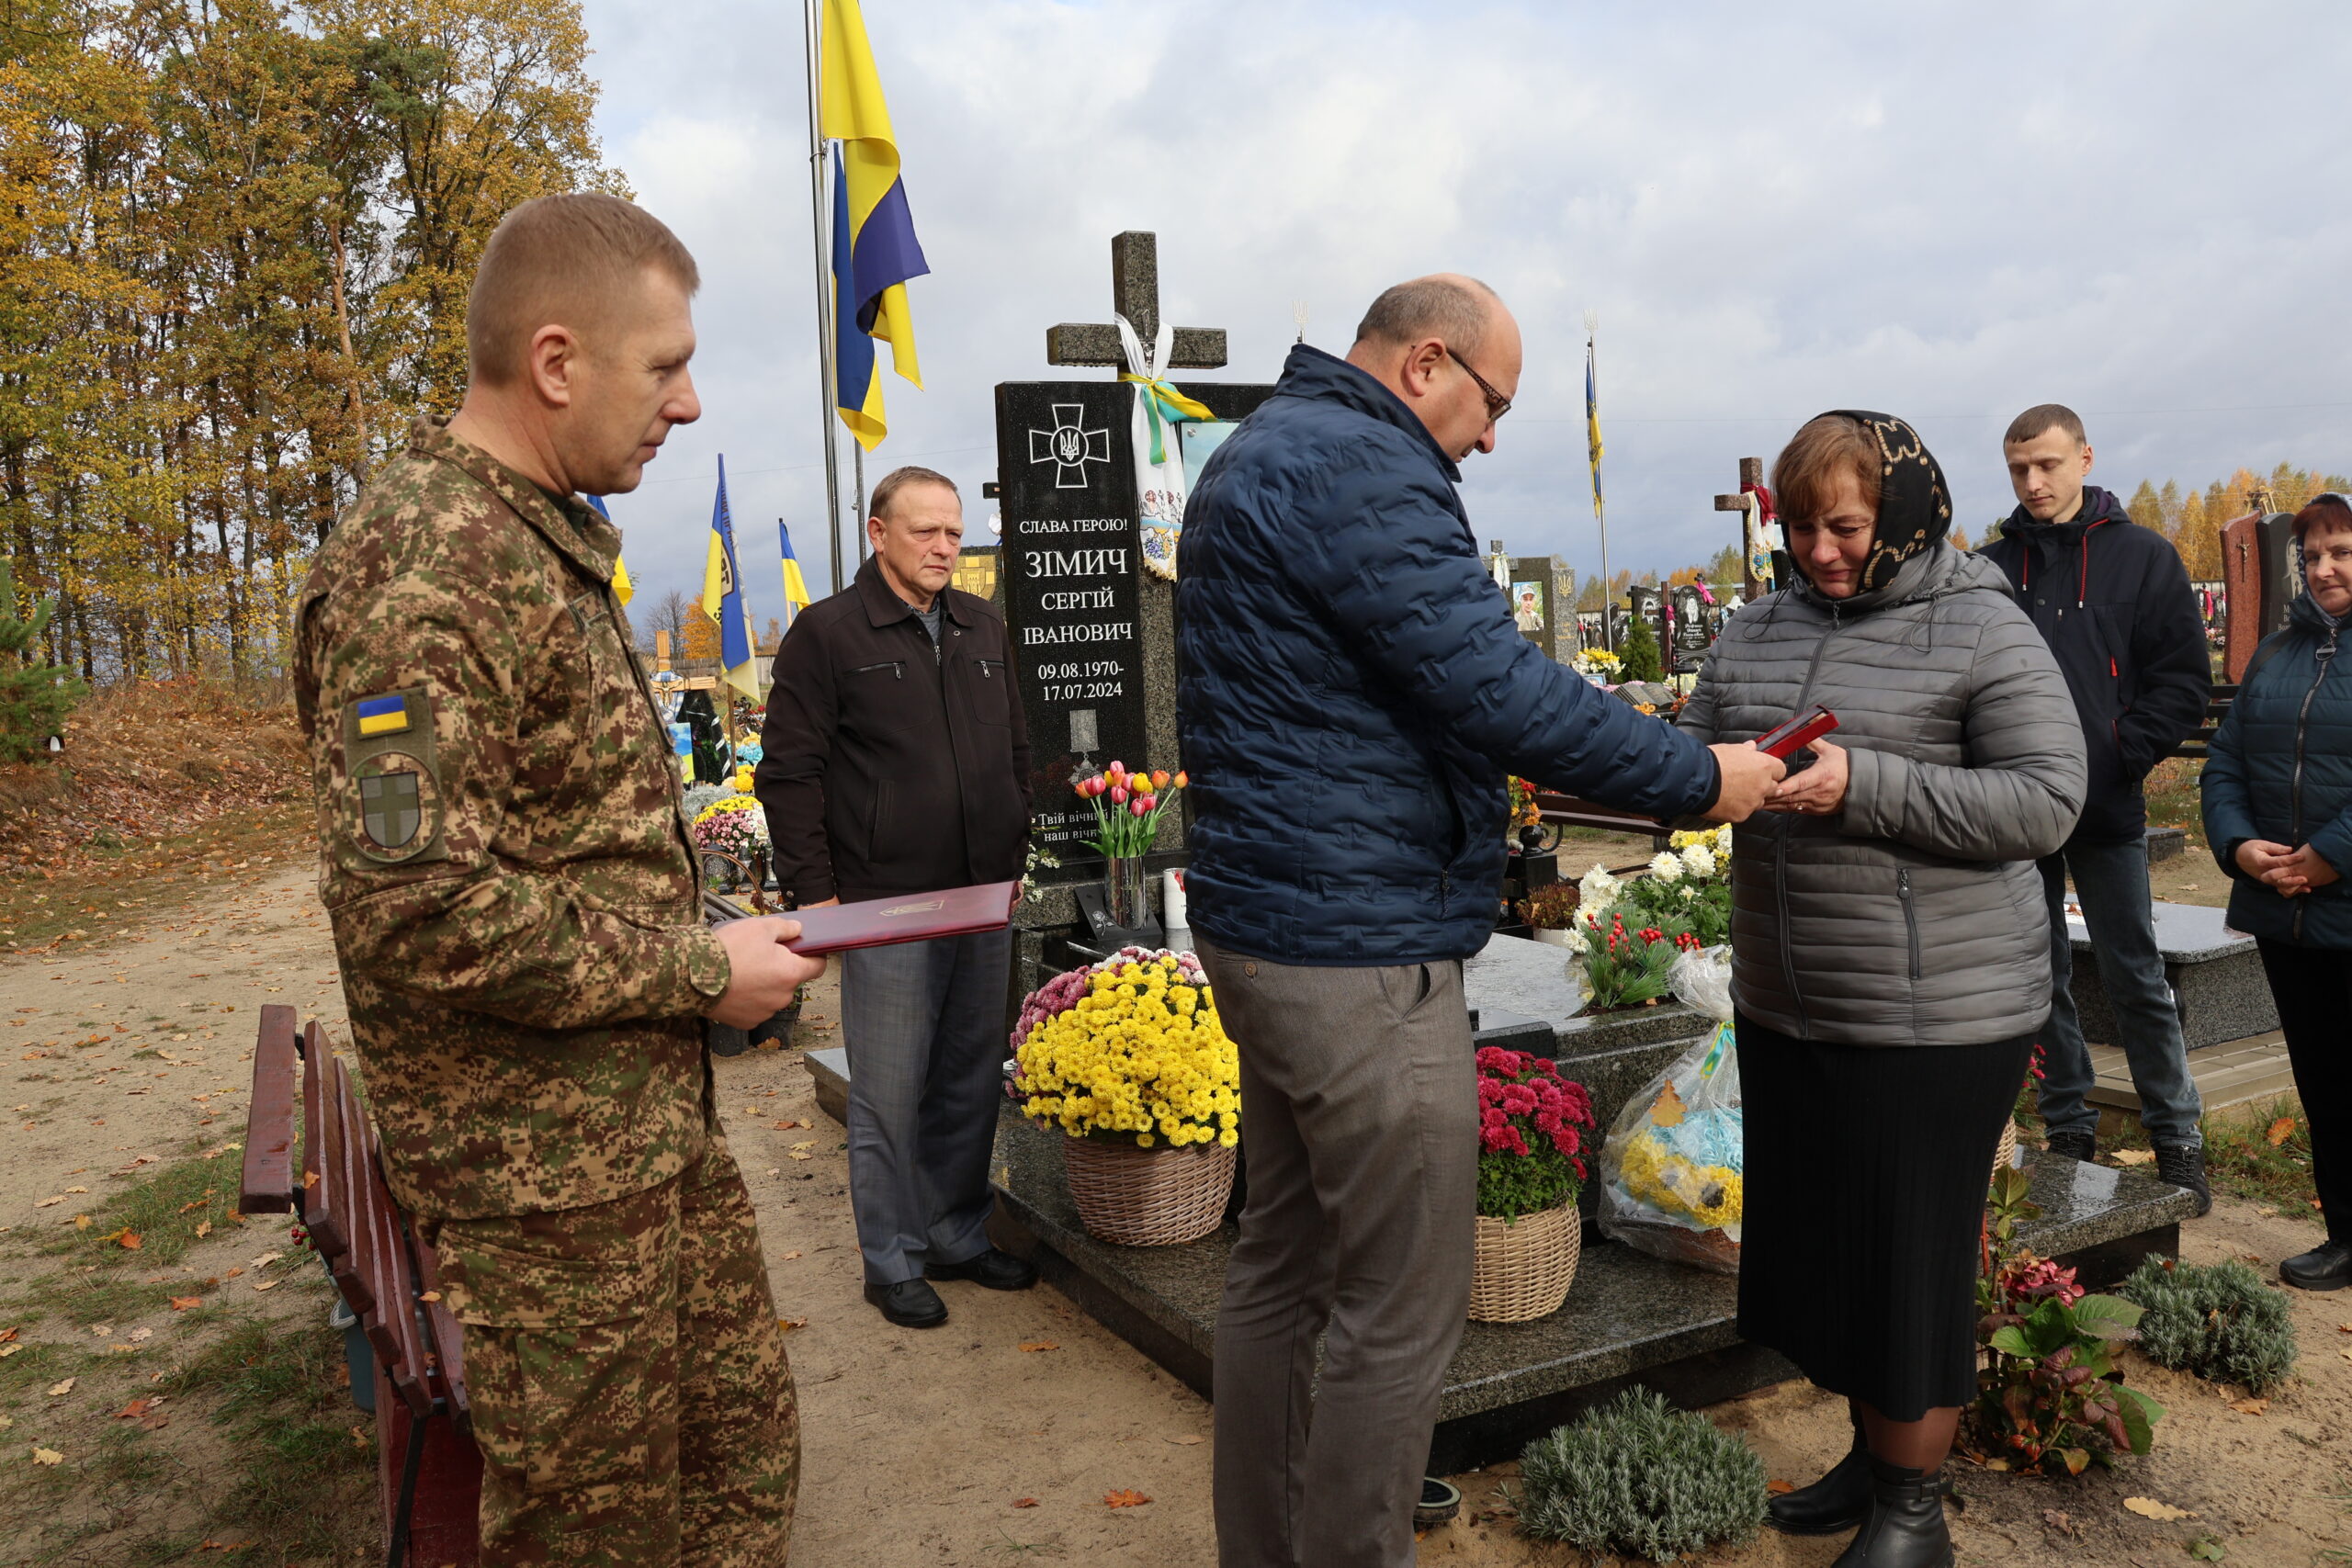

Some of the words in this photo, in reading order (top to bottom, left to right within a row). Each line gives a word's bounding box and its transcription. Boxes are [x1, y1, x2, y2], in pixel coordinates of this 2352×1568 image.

[1019, 519, 1070, 535] СЛАВА
[1072, 517, 1128, 534] ГЕРОЮ!
[1025, 548, 1128, 578] ЗІМИЧ
[1041, 585, 1115, 611] СЕРГІЙ
[1023, 622, 1133, 645] ІВАНОВИЧ
[1037, 660, 1125, 680] 09.08.1970-
[1043, 681, 1123, 701] 17.07.2024
[1038, 812, 1065, 825] Твій
[1044, 830, 1069, 842] наш
